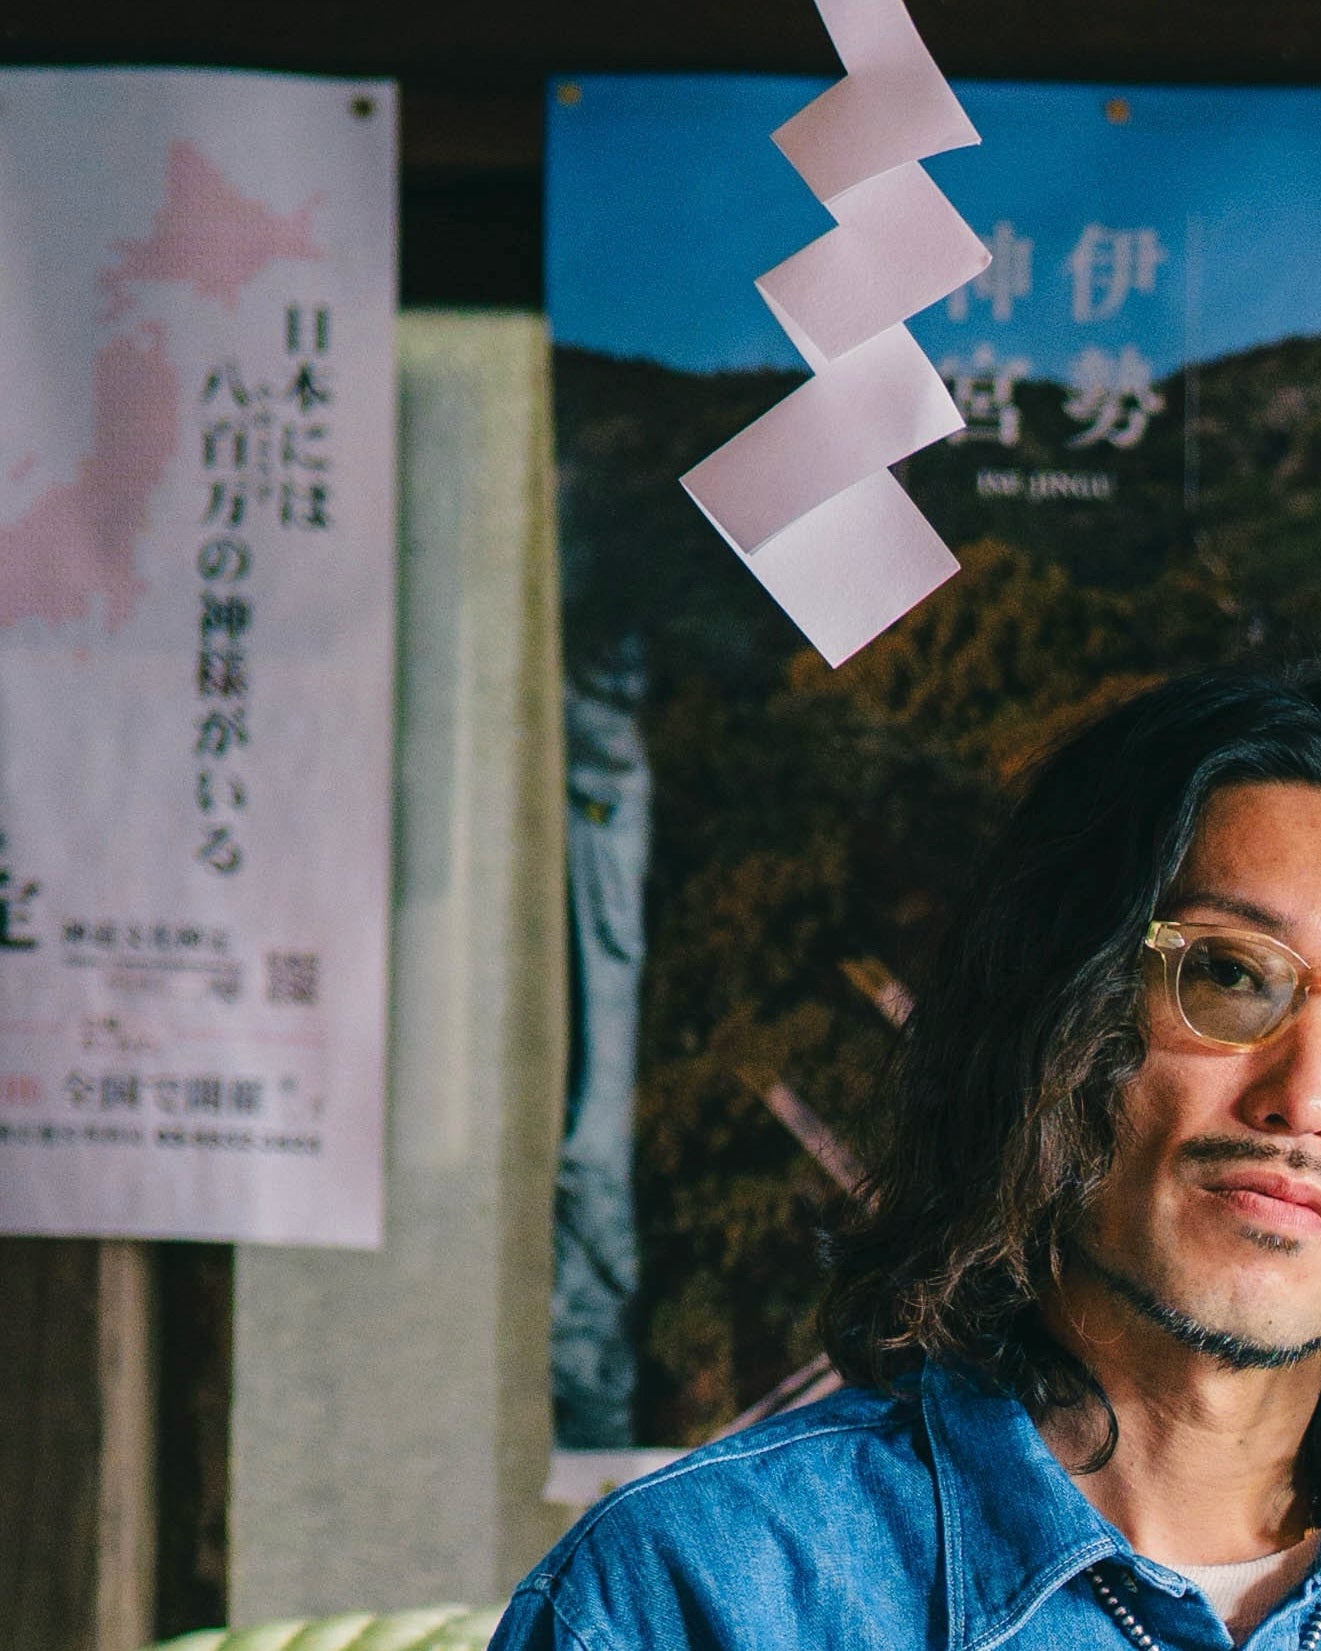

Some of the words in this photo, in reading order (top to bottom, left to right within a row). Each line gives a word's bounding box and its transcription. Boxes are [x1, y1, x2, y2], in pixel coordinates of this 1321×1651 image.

[280, 304, 332, 528] 日本には
[1061, 222, 1167, 449] 伊勢
